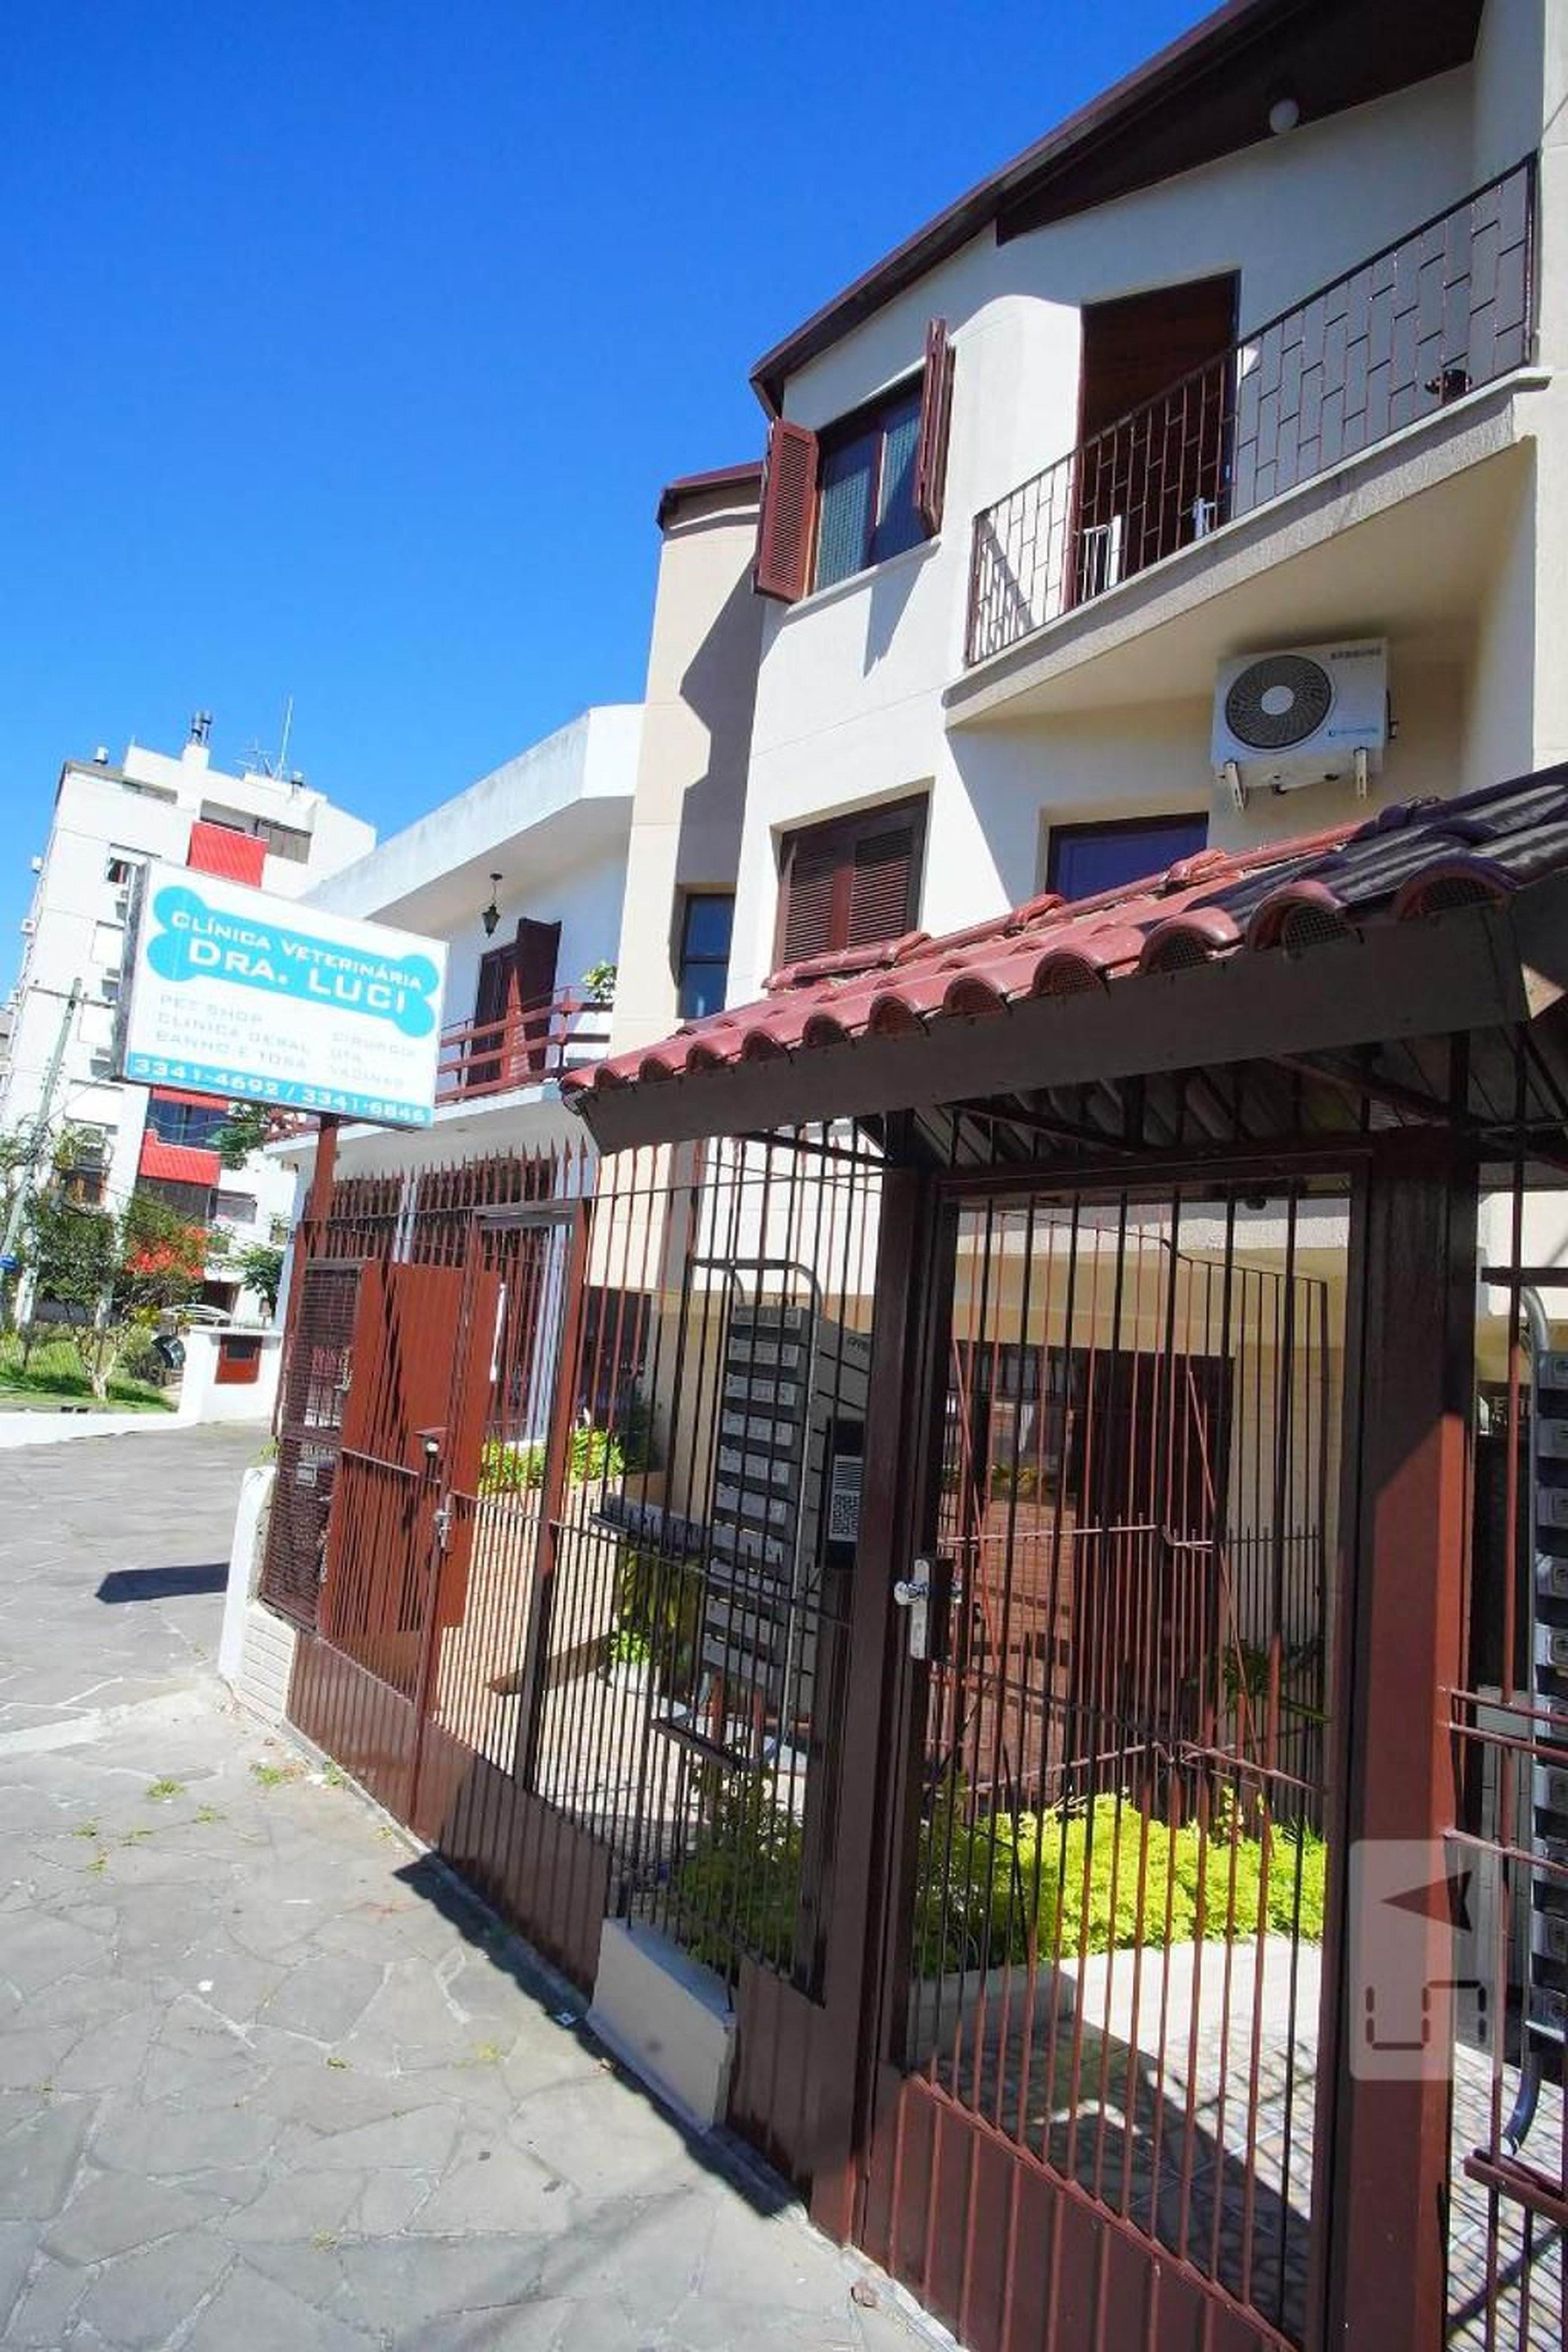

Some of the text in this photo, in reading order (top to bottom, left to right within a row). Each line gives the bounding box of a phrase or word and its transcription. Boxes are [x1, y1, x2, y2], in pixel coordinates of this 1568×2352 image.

[171, 911, 421, 991] CLÍNICA VETERINÁRIA
[189, 938, 405, 1013] DRA. LUCI
[134, 1058, 278, 1096] 3341-4692
